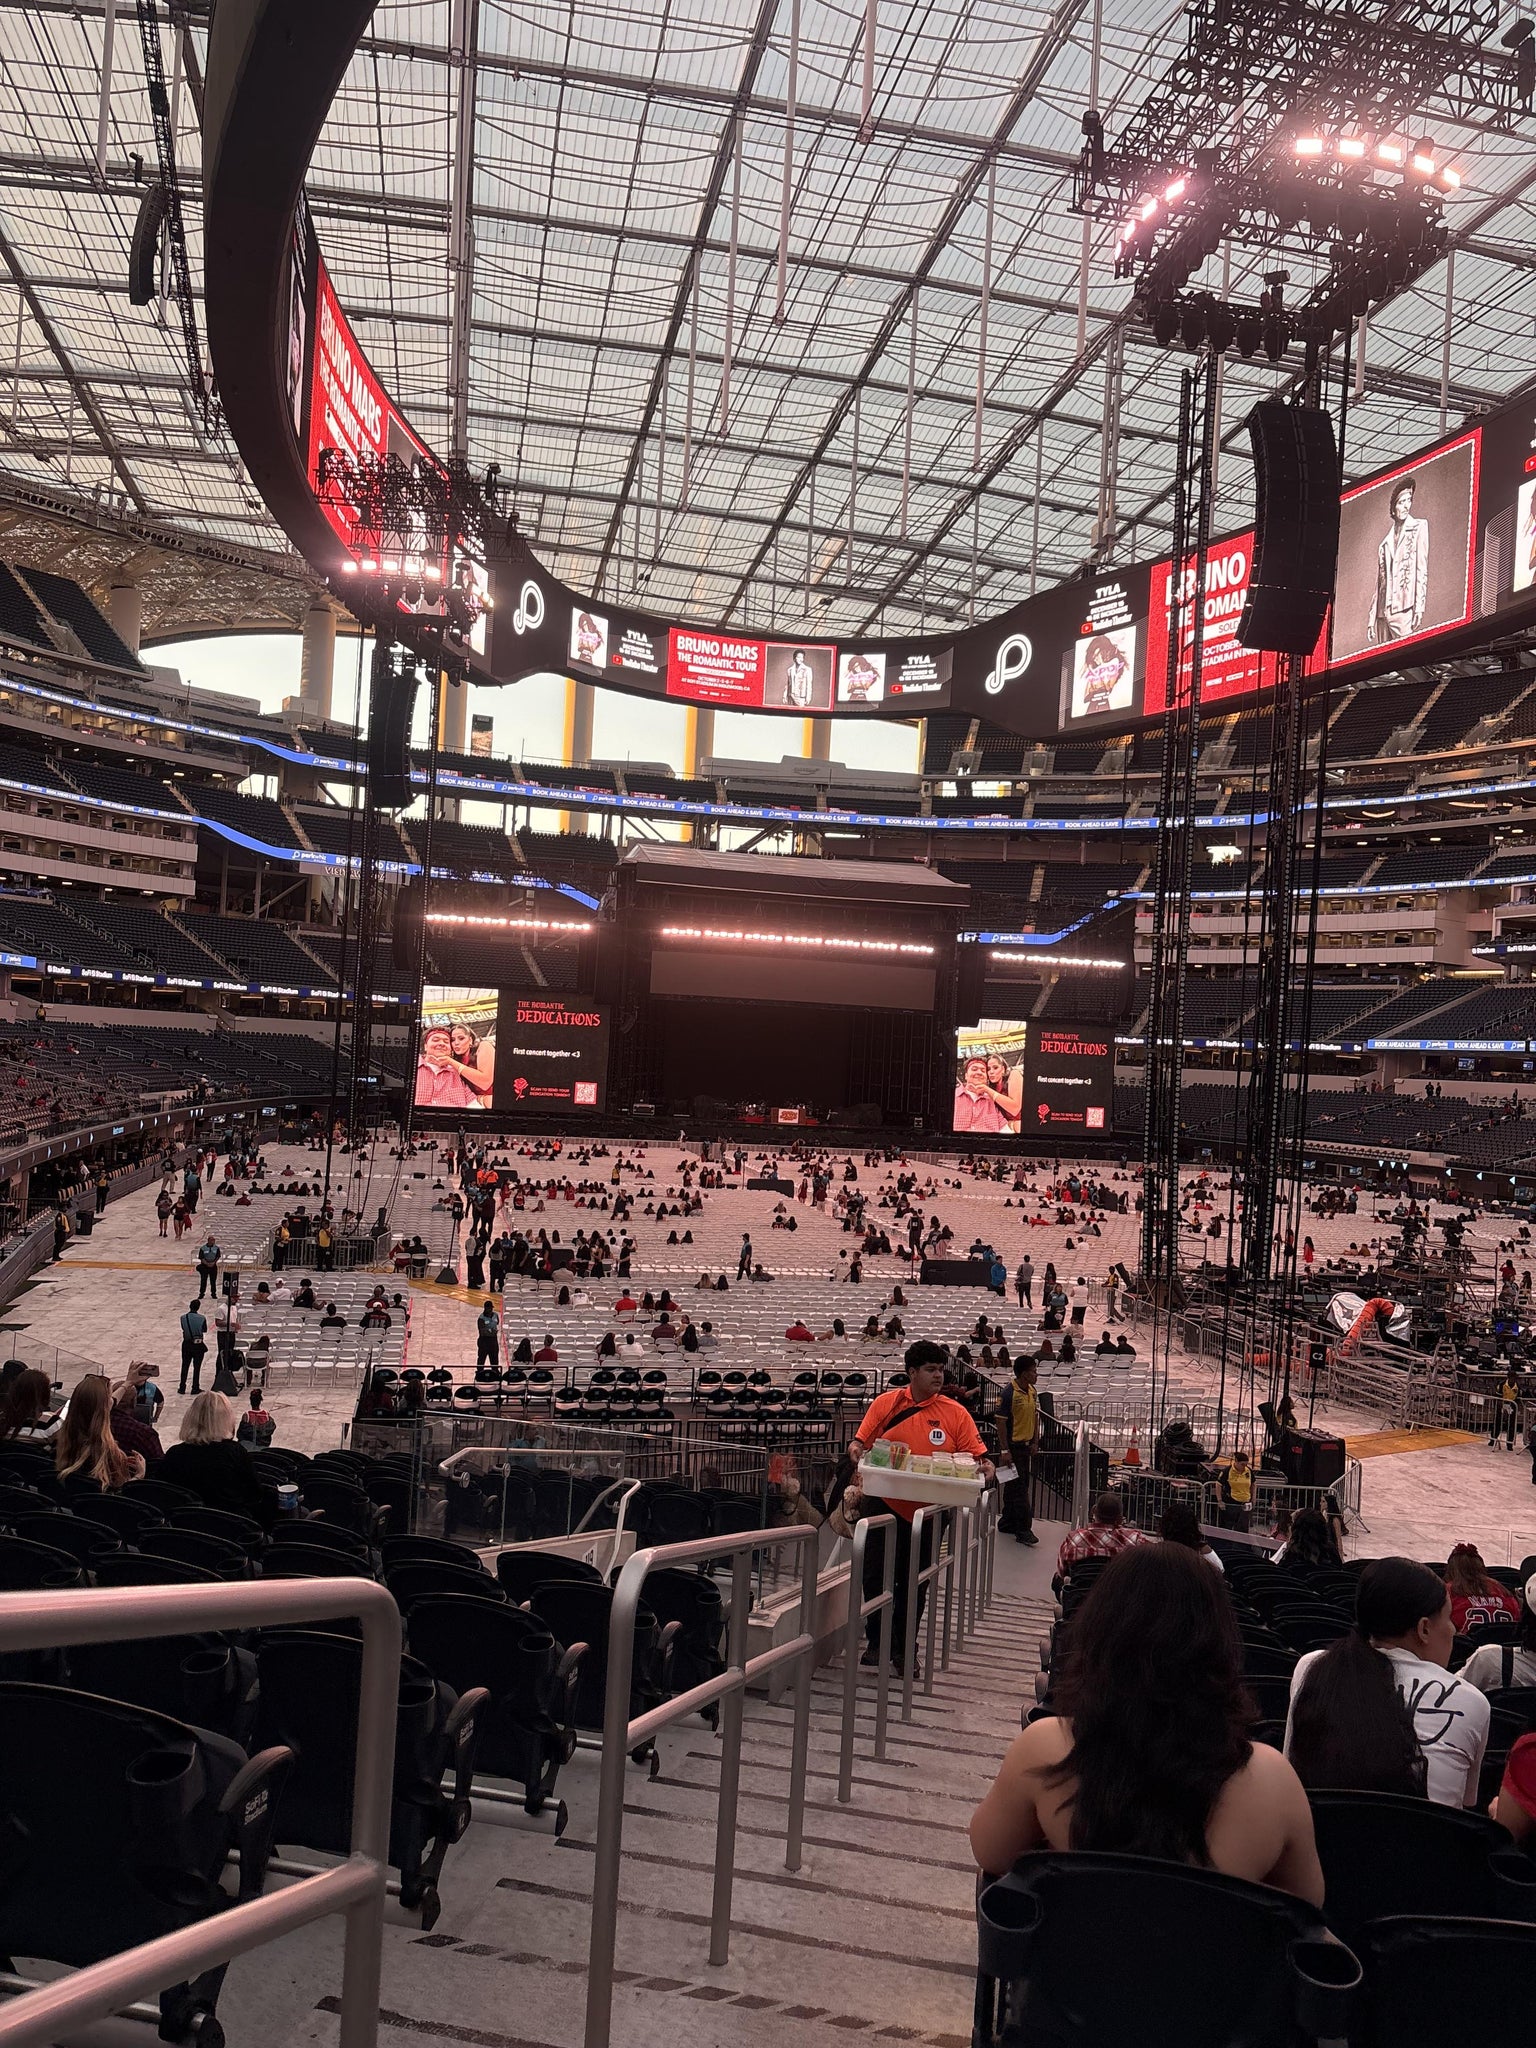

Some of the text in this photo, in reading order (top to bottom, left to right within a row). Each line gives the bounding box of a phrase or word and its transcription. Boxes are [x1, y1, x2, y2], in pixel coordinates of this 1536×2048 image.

[320, 290, 351, 394] BRUNO
[352, 365, 382, 444] MARS
[1096, 583, 1120, 598] TYLA
[627, 629, 647, 642] TYLA
[677, 635, 720, 656] BRUNO
[722, 643, 758, 660] MARS
[677, 652, 757, 672] THE ROMANTIC TOUR
[908, 655, 930, 665] TYLA
[517, 1010, 600, 1026] DEDICATIONS
[547, 1049, 570, 1058] together
[1040, 1040, 1108, 1056] DEDICATIONS
